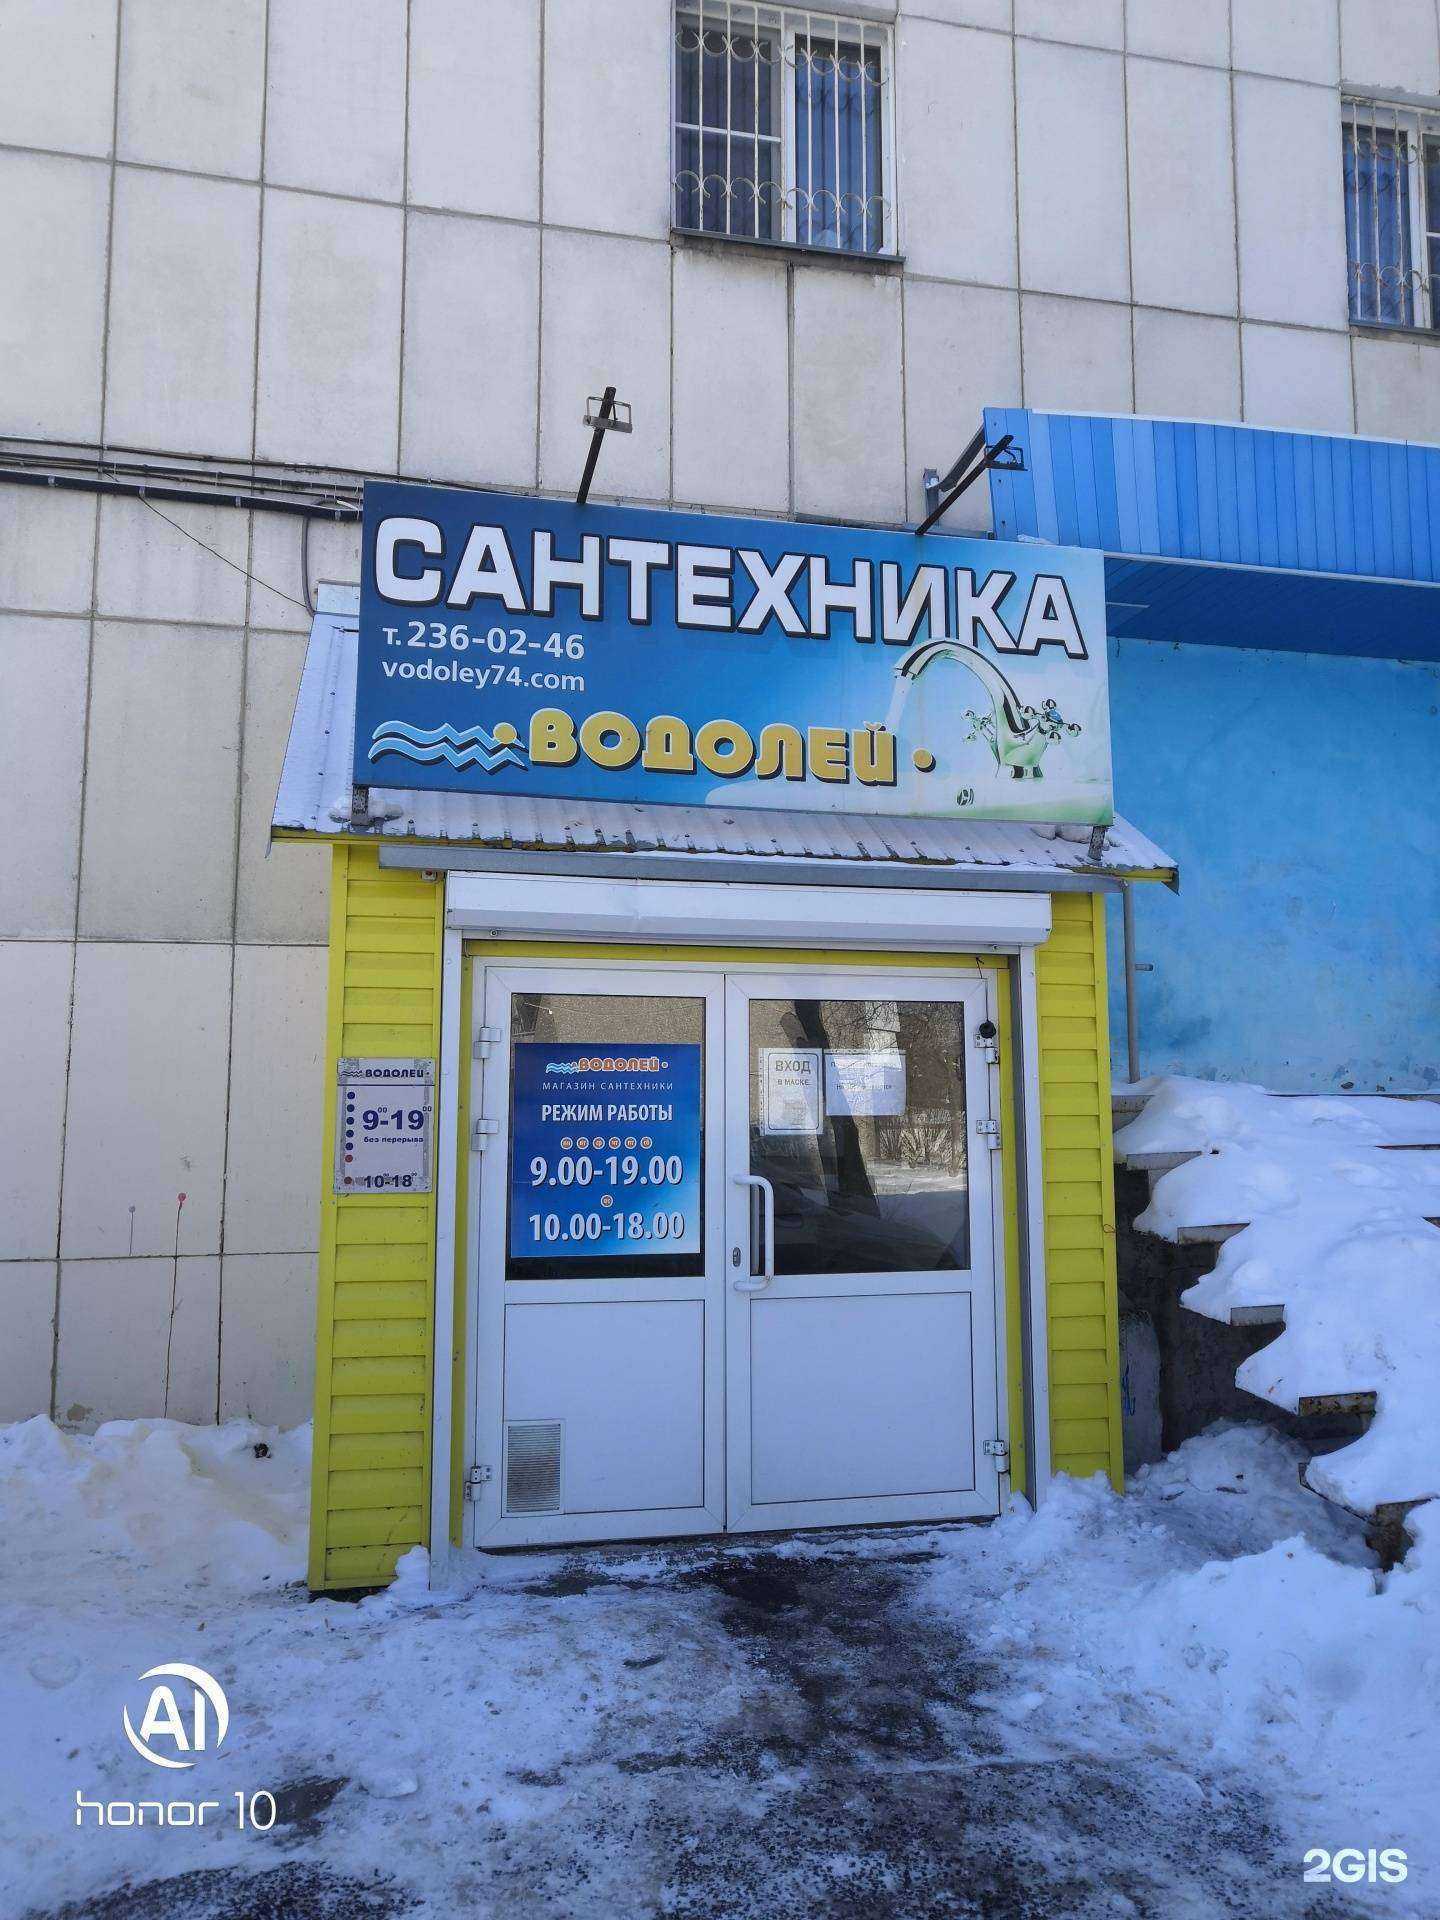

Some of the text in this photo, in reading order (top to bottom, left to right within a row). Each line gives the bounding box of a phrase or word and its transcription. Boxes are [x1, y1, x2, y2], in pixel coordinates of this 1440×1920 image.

[374, 517, 1088, 659] САНТЕХНИКА
[407, 620, 585, 660] 236-02-46
[381, 658, 586, 692] vodoley74.com
[528, 707, 898, 787] ВОДОЛЕЙ
[578, 1056, 660, 1072] ВОДОЛЕЙ
[775, 1060, 811, 1075] ВХОД
[542, 1082, 673, 1091] МАГАЗИН САНТЕХНИКИ
[541, 1104, 673, 1122] РЕЖИМ РАБОТЫ
[530, 1155, 683, 1187] 9.00-19.00
[529, 1212, 685, 1241] 10.00-18.00
